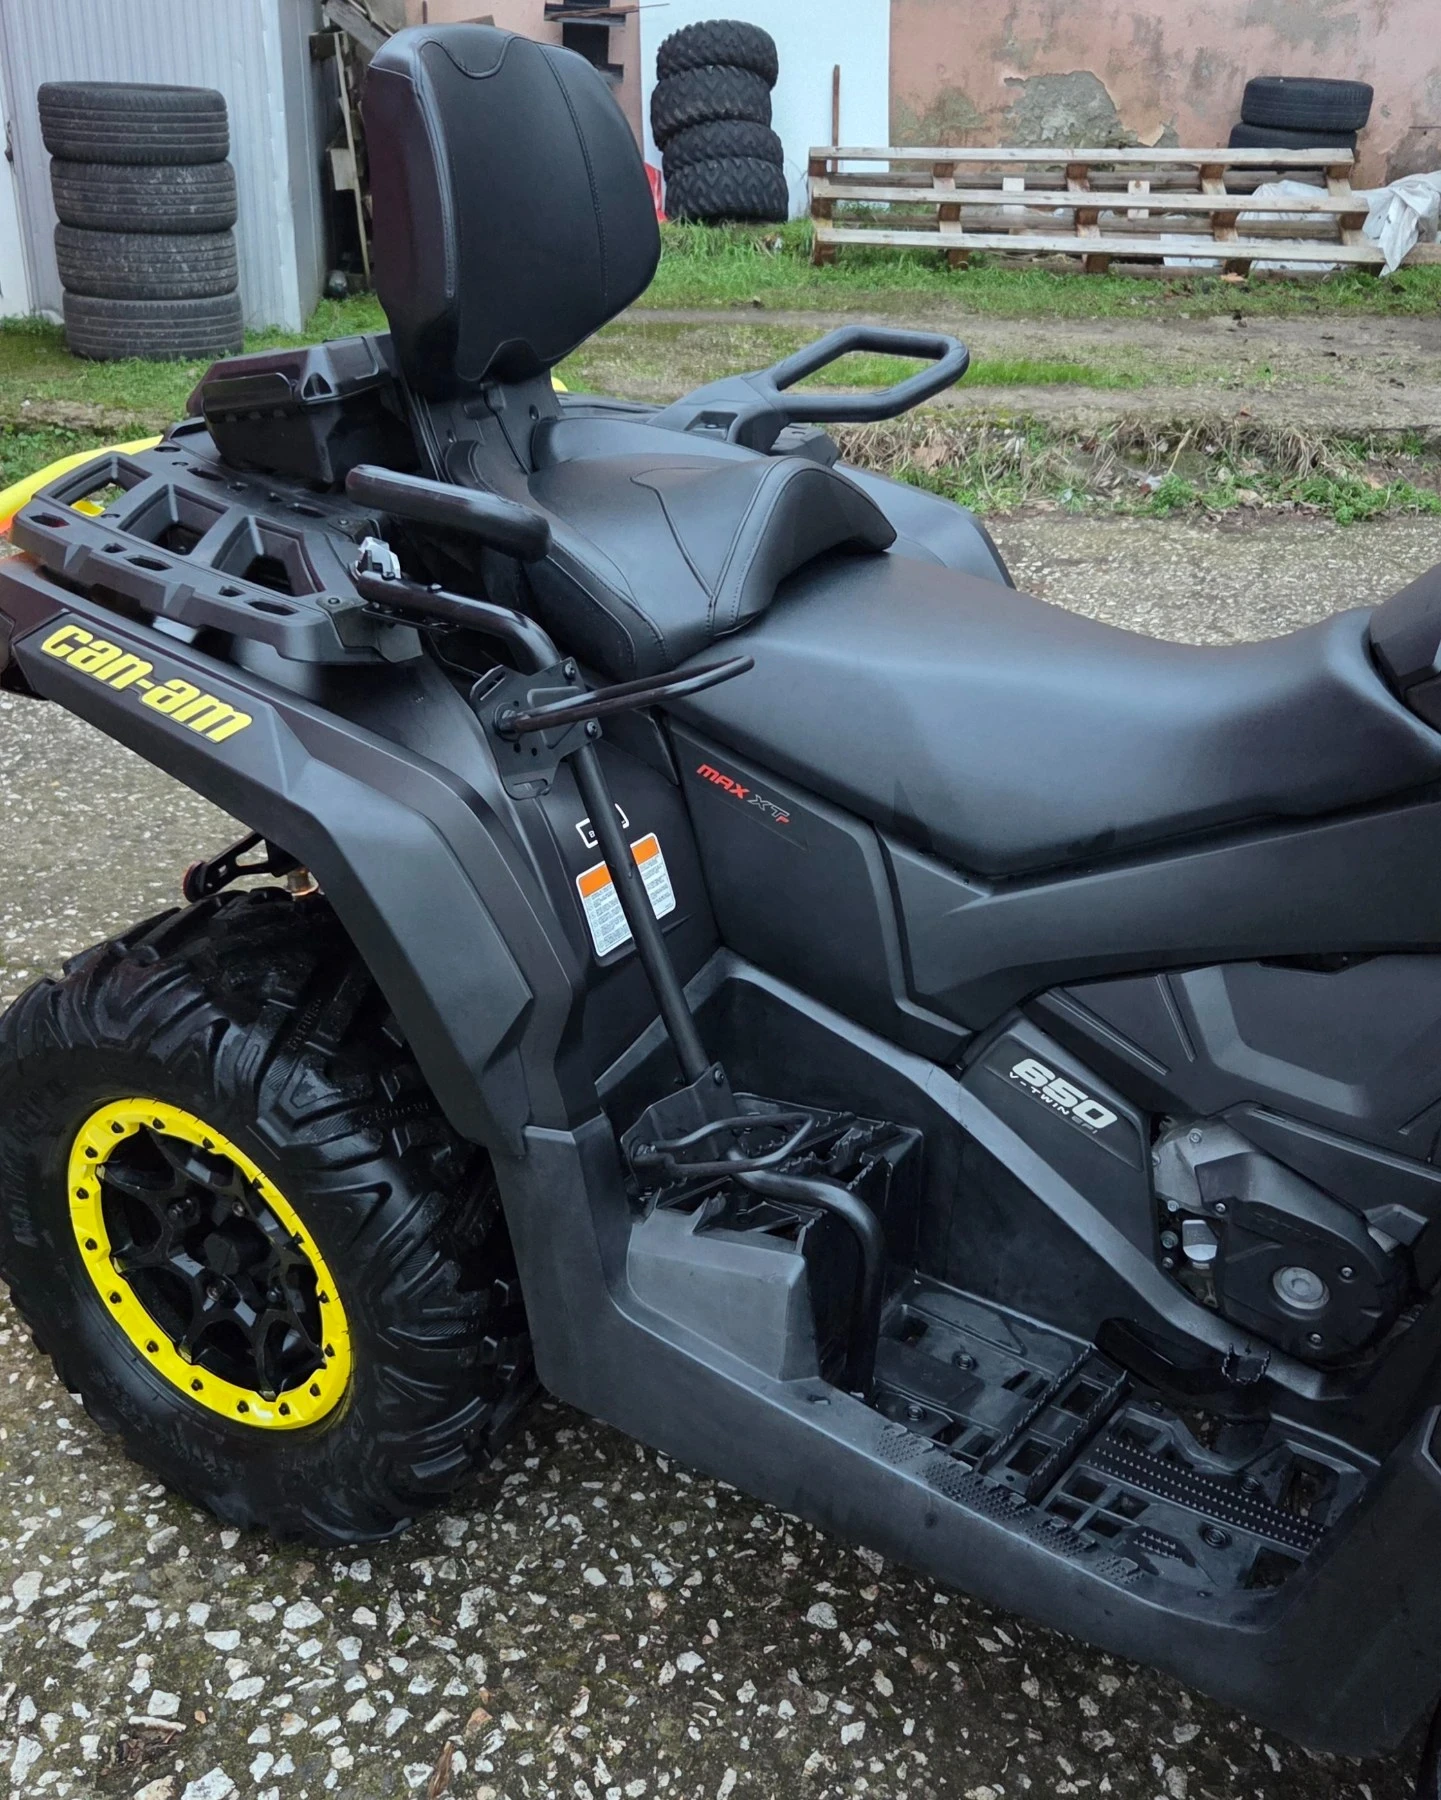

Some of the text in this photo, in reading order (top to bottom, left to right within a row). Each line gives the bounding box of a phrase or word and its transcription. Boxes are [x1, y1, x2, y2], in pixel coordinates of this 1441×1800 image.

[41, 624, 253, 743] can-am
[696, 763, 750, 799] MAX
[1012, 1058, 1118, 1129] 650
